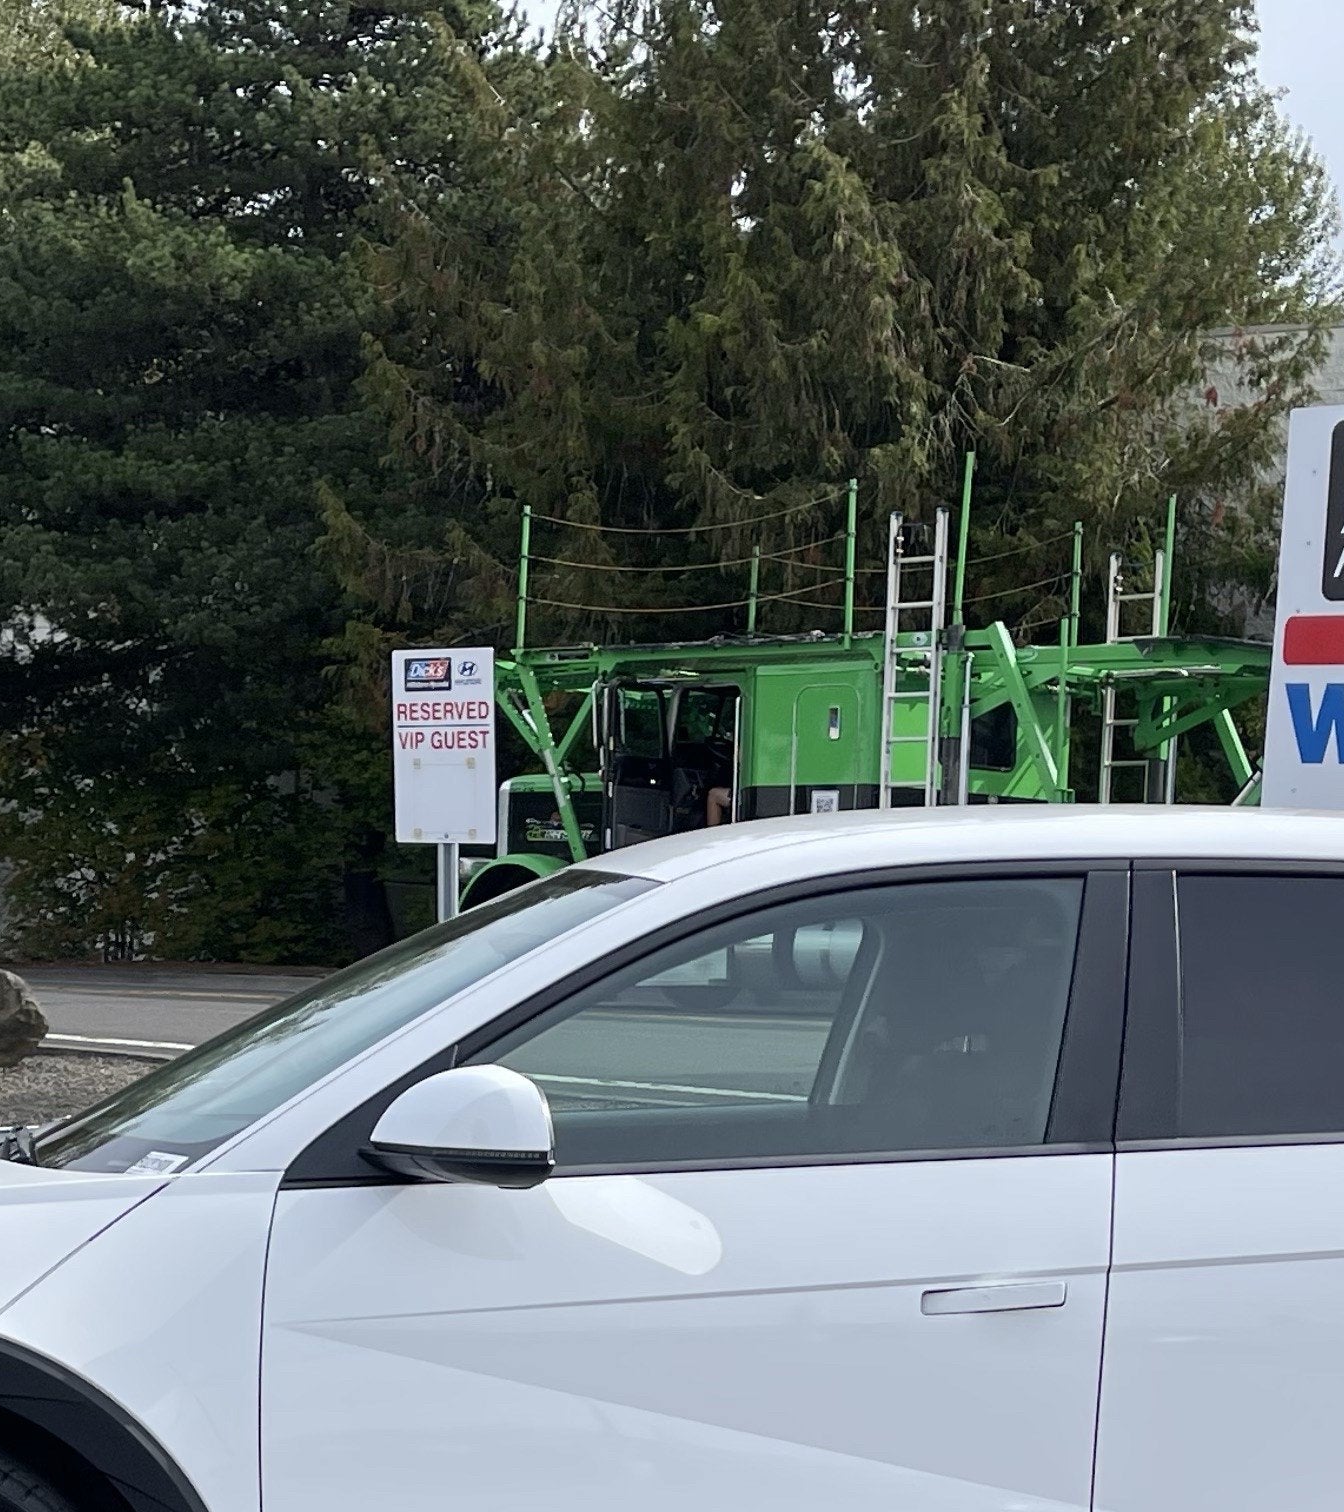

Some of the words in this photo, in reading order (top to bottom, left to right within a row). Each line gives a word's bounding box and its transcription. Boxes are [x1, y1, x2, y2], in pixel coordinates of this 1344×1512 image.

[396, 701, 490, 721] RESERVED
[398, 730, 425, 750] VIP
[430, 729, 490, 750] GUEST
